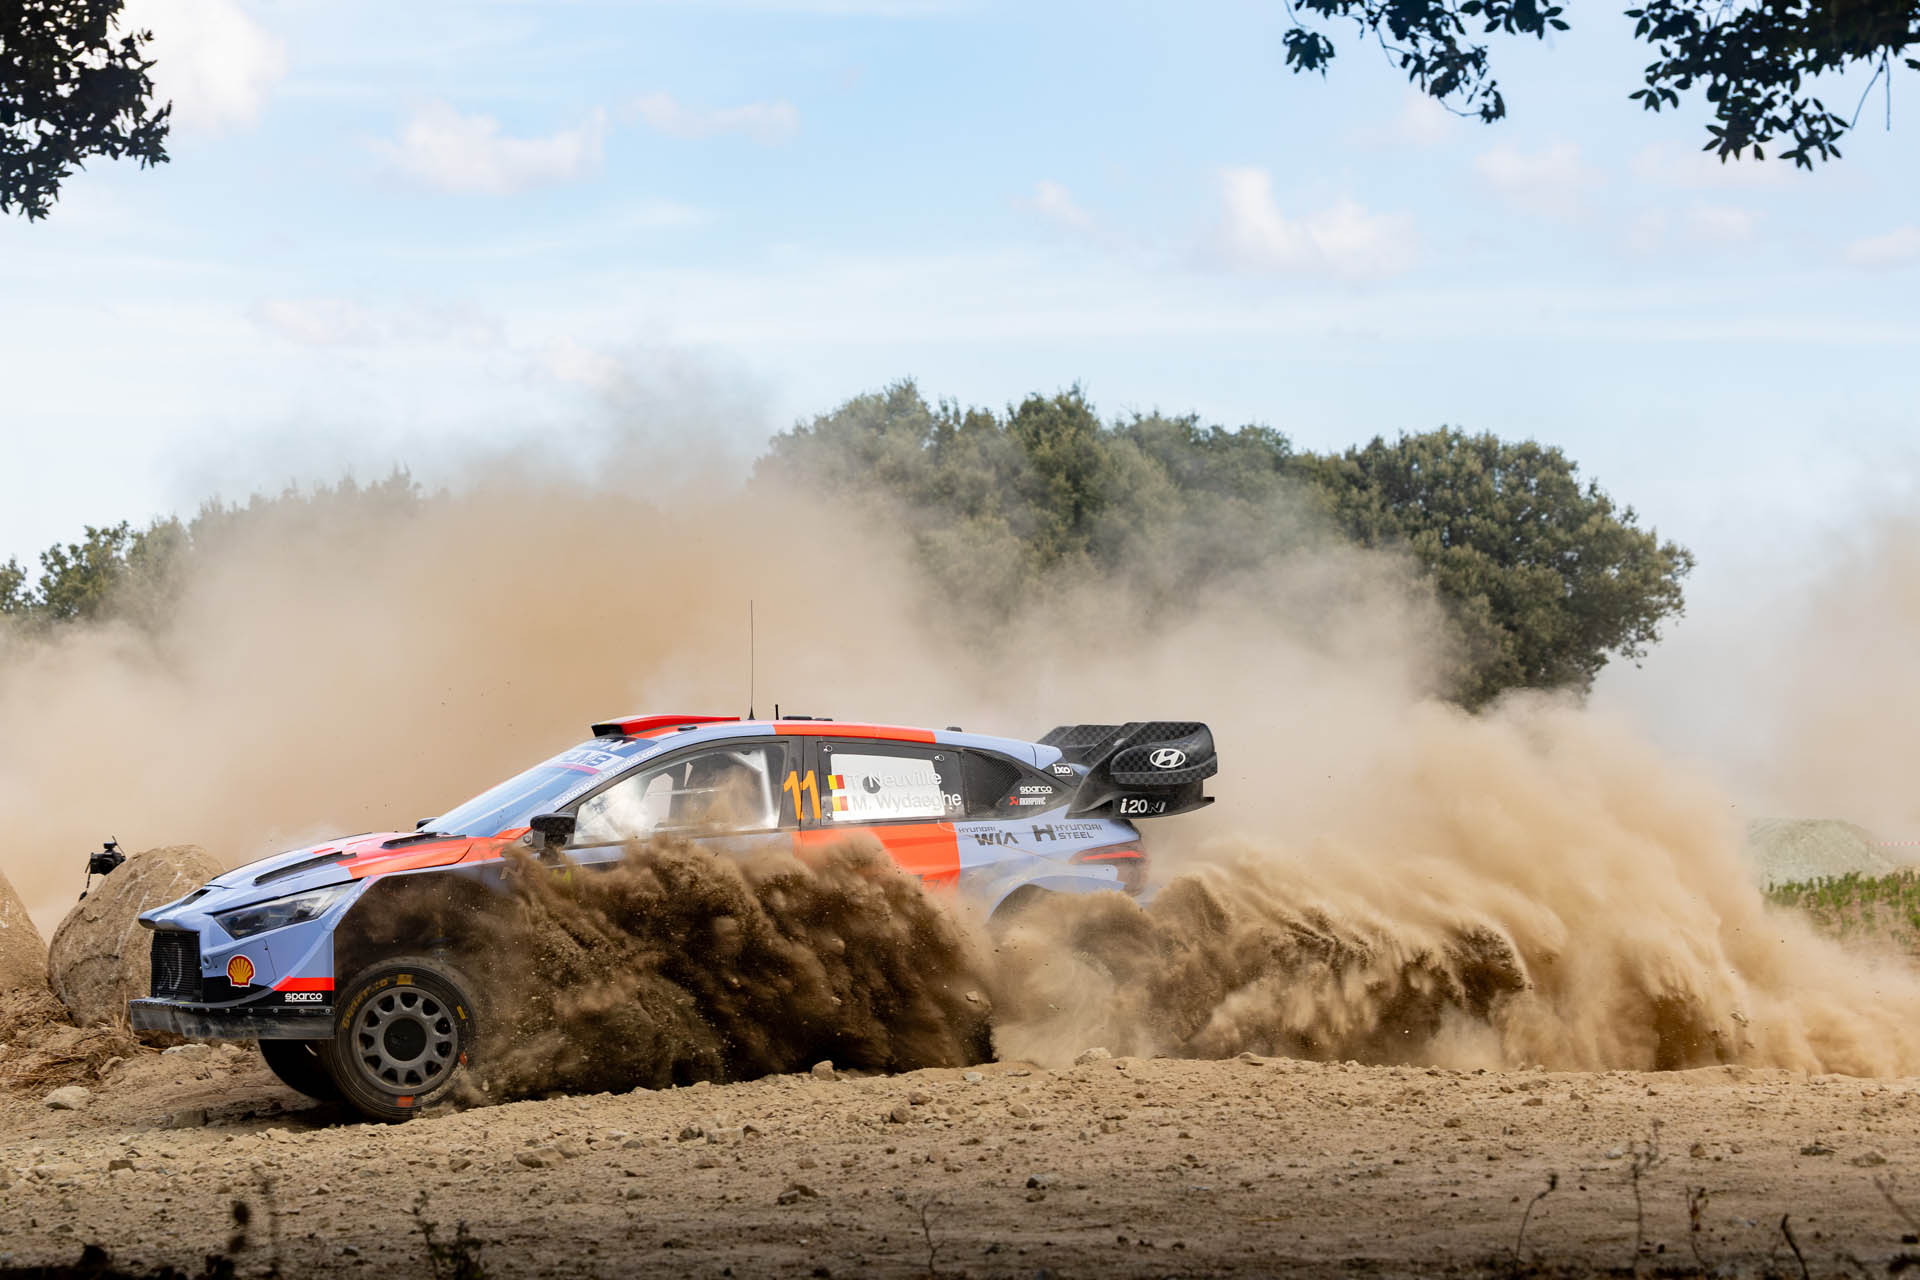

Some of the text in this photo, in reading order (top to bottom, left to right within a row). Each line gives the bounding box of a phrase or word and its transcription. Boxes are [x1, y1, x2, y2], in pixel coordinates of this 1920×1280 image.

[784, 770, 822, 820] 11
[1019, 785, 1053, 795] sparco
[1055, 823, 1103, 832] HYUNDAI
[1058, 831, 1095, 840] STEEL
[284, 992, 323, 1003] sparco
